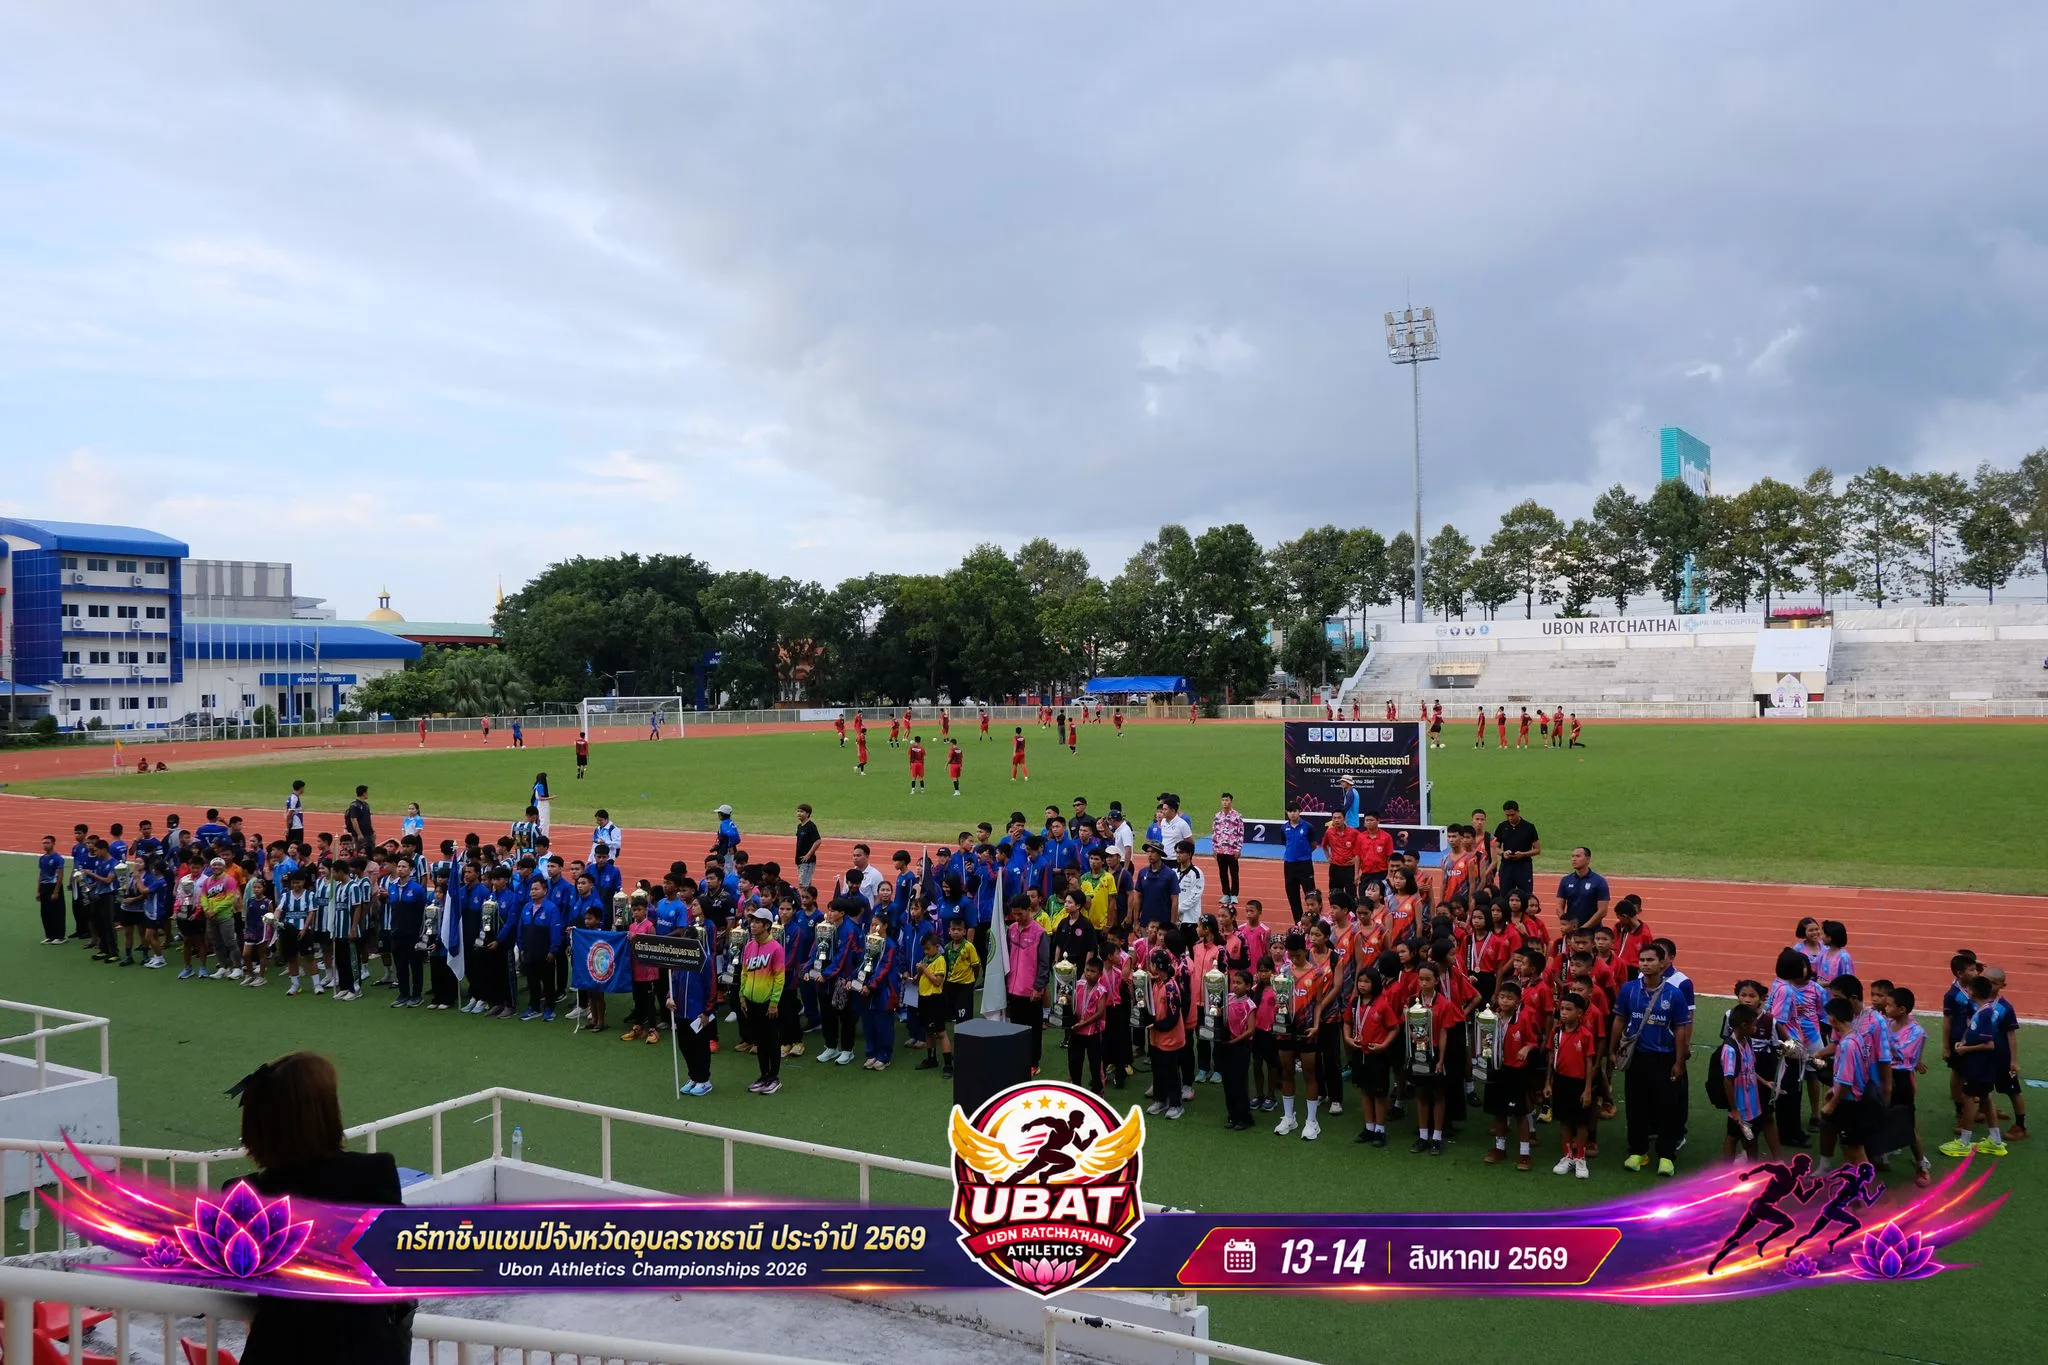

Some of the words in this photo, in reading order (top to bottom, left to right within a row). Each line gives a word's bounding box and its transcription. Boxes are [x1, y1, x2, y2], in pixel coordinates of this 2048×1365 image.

[1542, 620, 1584, 635] UBON
[1590, 618, 1681, 634] RATCHATHA
[1725, 618, 1761, 626] HOSPITAL
[1253, 824, 1266, 842] 2
[958, 1008, 966, 1018] 19
